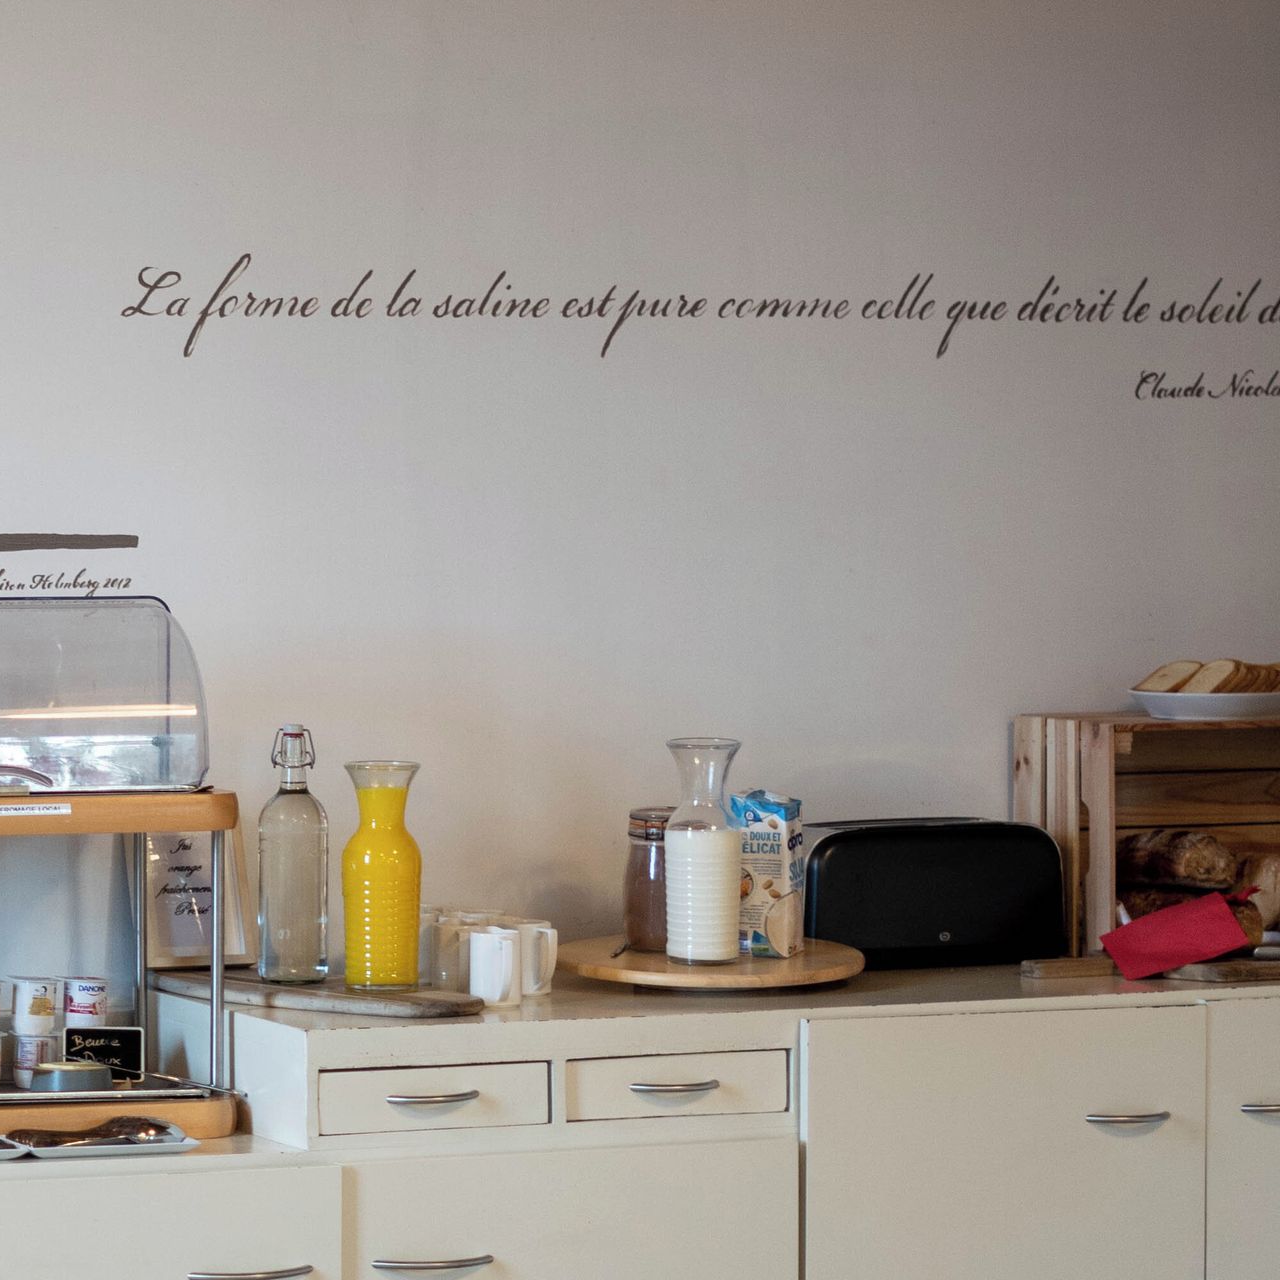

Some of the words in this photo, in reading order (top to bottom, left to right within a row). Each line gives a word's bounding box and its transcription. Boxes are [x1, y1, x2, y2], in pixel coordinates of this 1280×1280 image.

[121, 266, 191, 318] La
[183, 253, 319, 357] forme
[330, 269, 373, 318] de
[386, 269, 423, 318] la
[432, 270, 550, 319] saline
[560, 284, 617, 319] est
[601, 289, 708, 358] pure
[718, 297, 851, 319] comme
[861, 273, 936, 321] celle
[936, 300, 1010, 359] que
[1017, 275, 1117, 323] décrit
[1122, 277, 1151, 323] le
[1160, 277, 1262, 324] soleil
[1258, 294, 1280, 324] d
[1135, 370, 1205, 400] Claude
[103, 577, 133, 590] 2012
[750, 832, 771, 841] DOUX
[773, 833, 782, 841] ET
[741, 840, 782, 855] ÉLICAT
[167, 865, 203, 878] orange
[77, 984, 106, 993] DANONE
